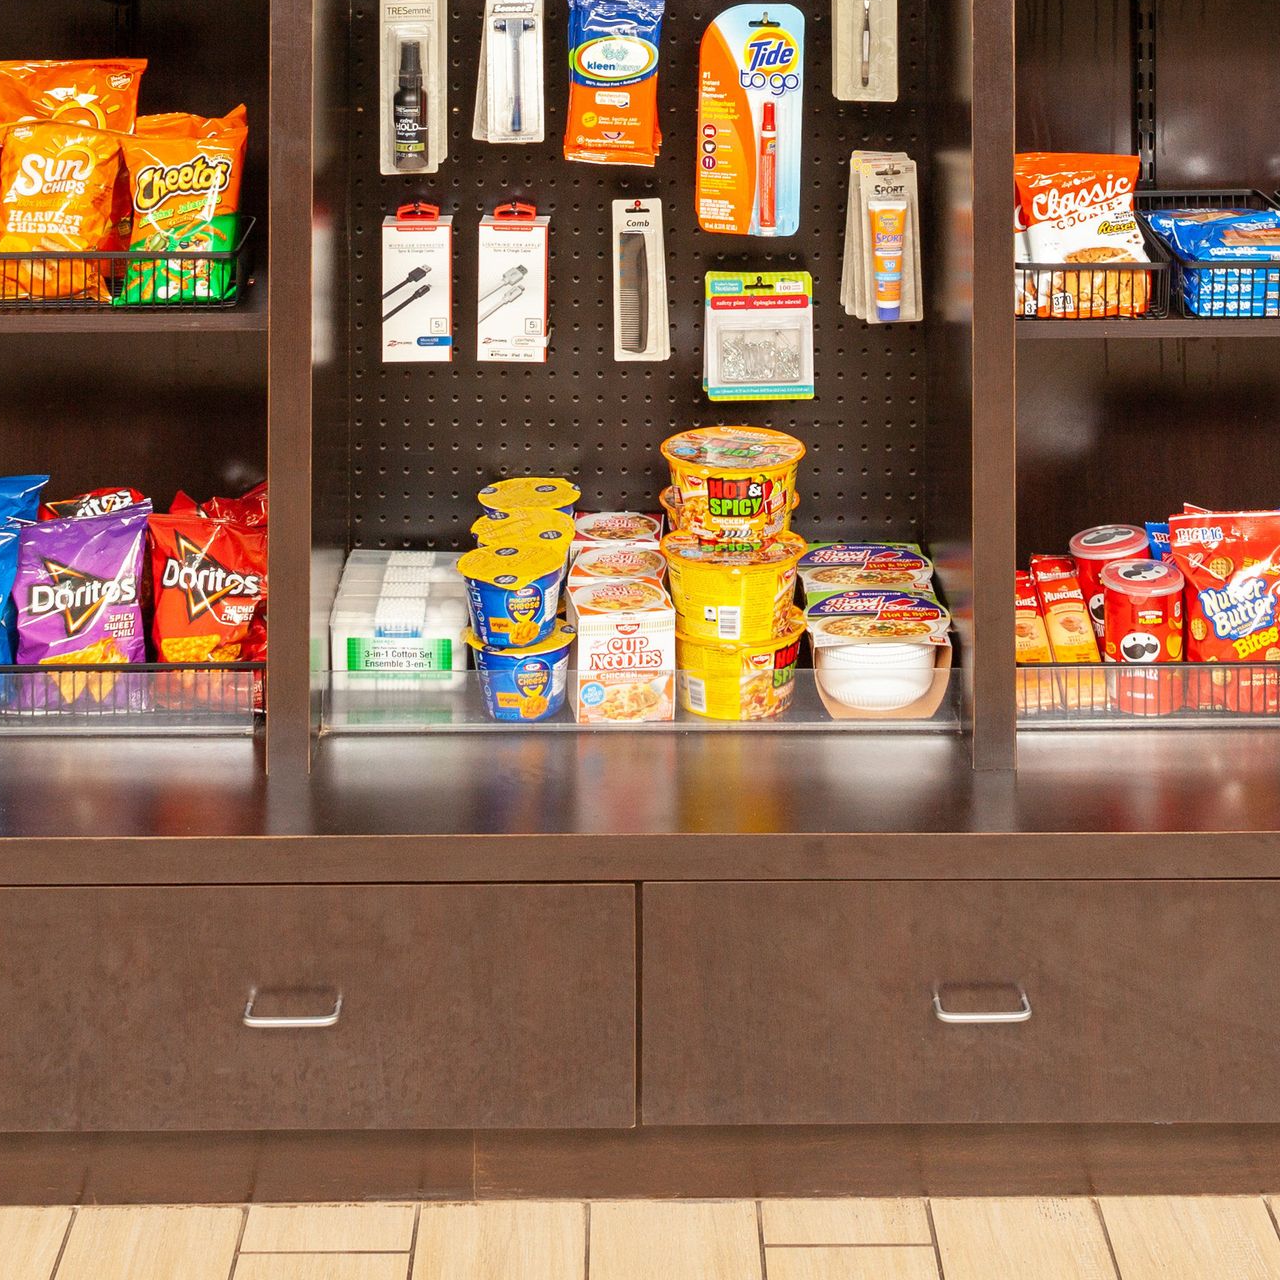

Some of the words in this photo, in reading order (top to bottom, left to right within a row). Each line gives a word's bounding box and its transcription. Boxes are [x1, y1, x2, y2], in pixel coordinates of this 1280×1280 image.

[387, 7, 431, 15] TRESemmé
[749, 41, 794, 72] Tide
[396, 123, 418, 131] HOLD
[874, 185, 904, 195] SPORT
[1032, 175, 1133, 221] Classic
[8, 210, 83, 224] HARVEST
[7, 221, 80, 236] CHEDDAR
[1097, 219, 1137, 236] Reese's
[876, 233, 903, 244] SPORT
[779, 284, 791, 292] 100
[711, 517, 745, 525] CHICKEN
[1044, 589, 1083, 603] MUNCHIES
[225, 605, 255, 615] NACHO
[109, 613, 135, 622] SPICY
[103, 621, 135, 631] SWEET
[112, 628, 135, 638] CHILI
[607, 637, 648, 652] CUP
[1232, 628, 1280, 658] Bites
[365, 650, 388, 660] 3-in-1
[392, 650, 417, 659] Cotton
[420, 650, 433, 659] Set
[590, 650, 662, 670] NOODLES
[365, 660, 403, 668] Ensemble
[406, 660, 432, 669] 3-en-1
